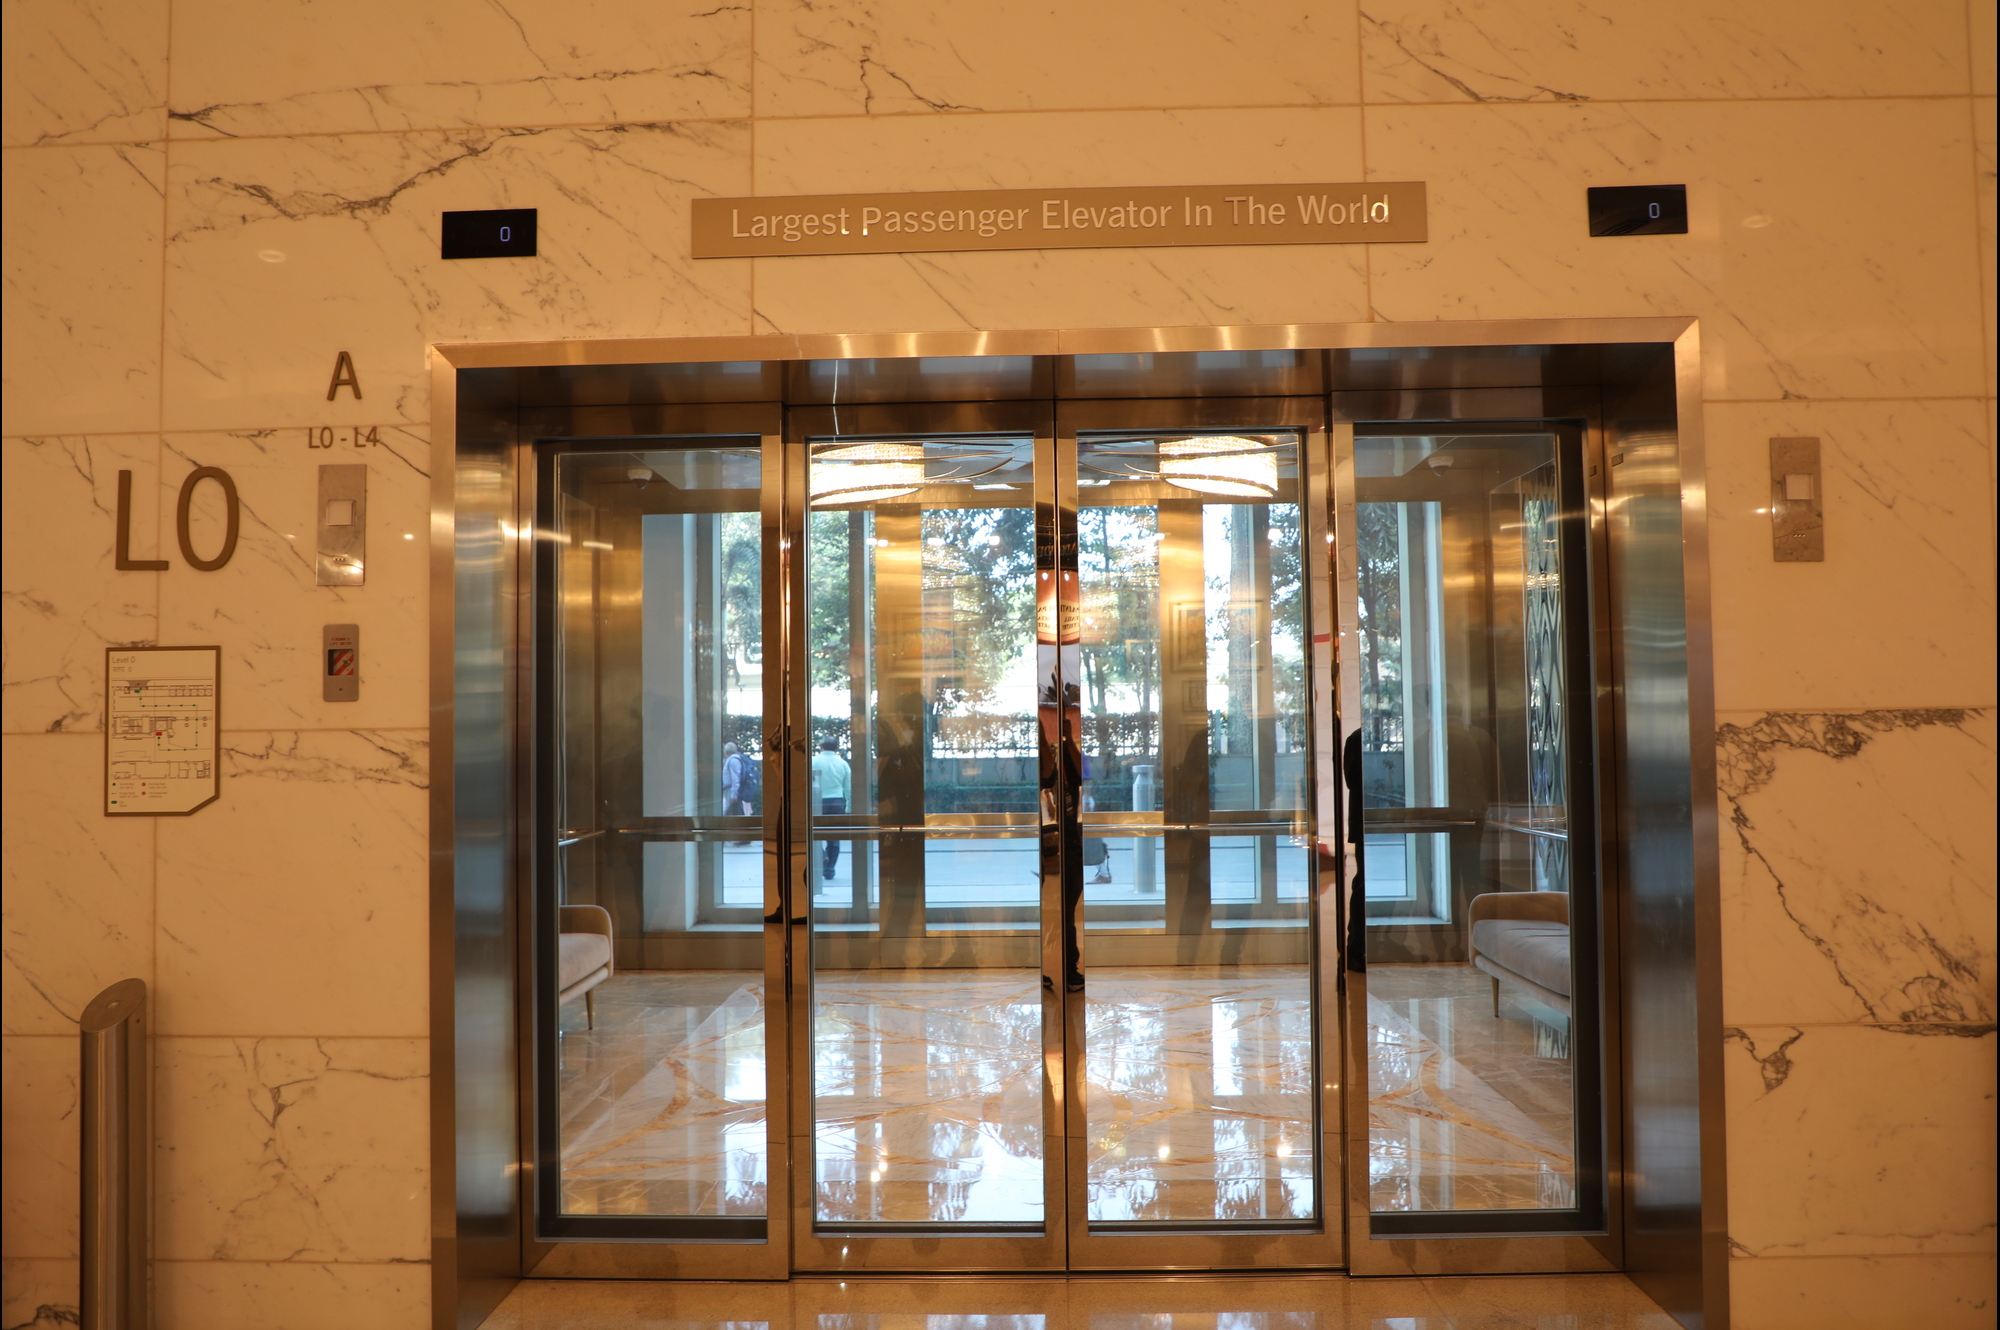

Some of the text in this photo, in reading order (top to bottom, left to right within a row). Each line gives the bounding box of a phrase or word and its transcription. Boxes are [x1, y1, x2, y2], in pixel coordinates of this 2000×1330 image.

[732, 193, 1390, 242] Largest Passenger Elevator In The World
[326, 350, 362, 401] A
[353, 425, 380, 448] L4
[112, 656, 129, 664] Level
